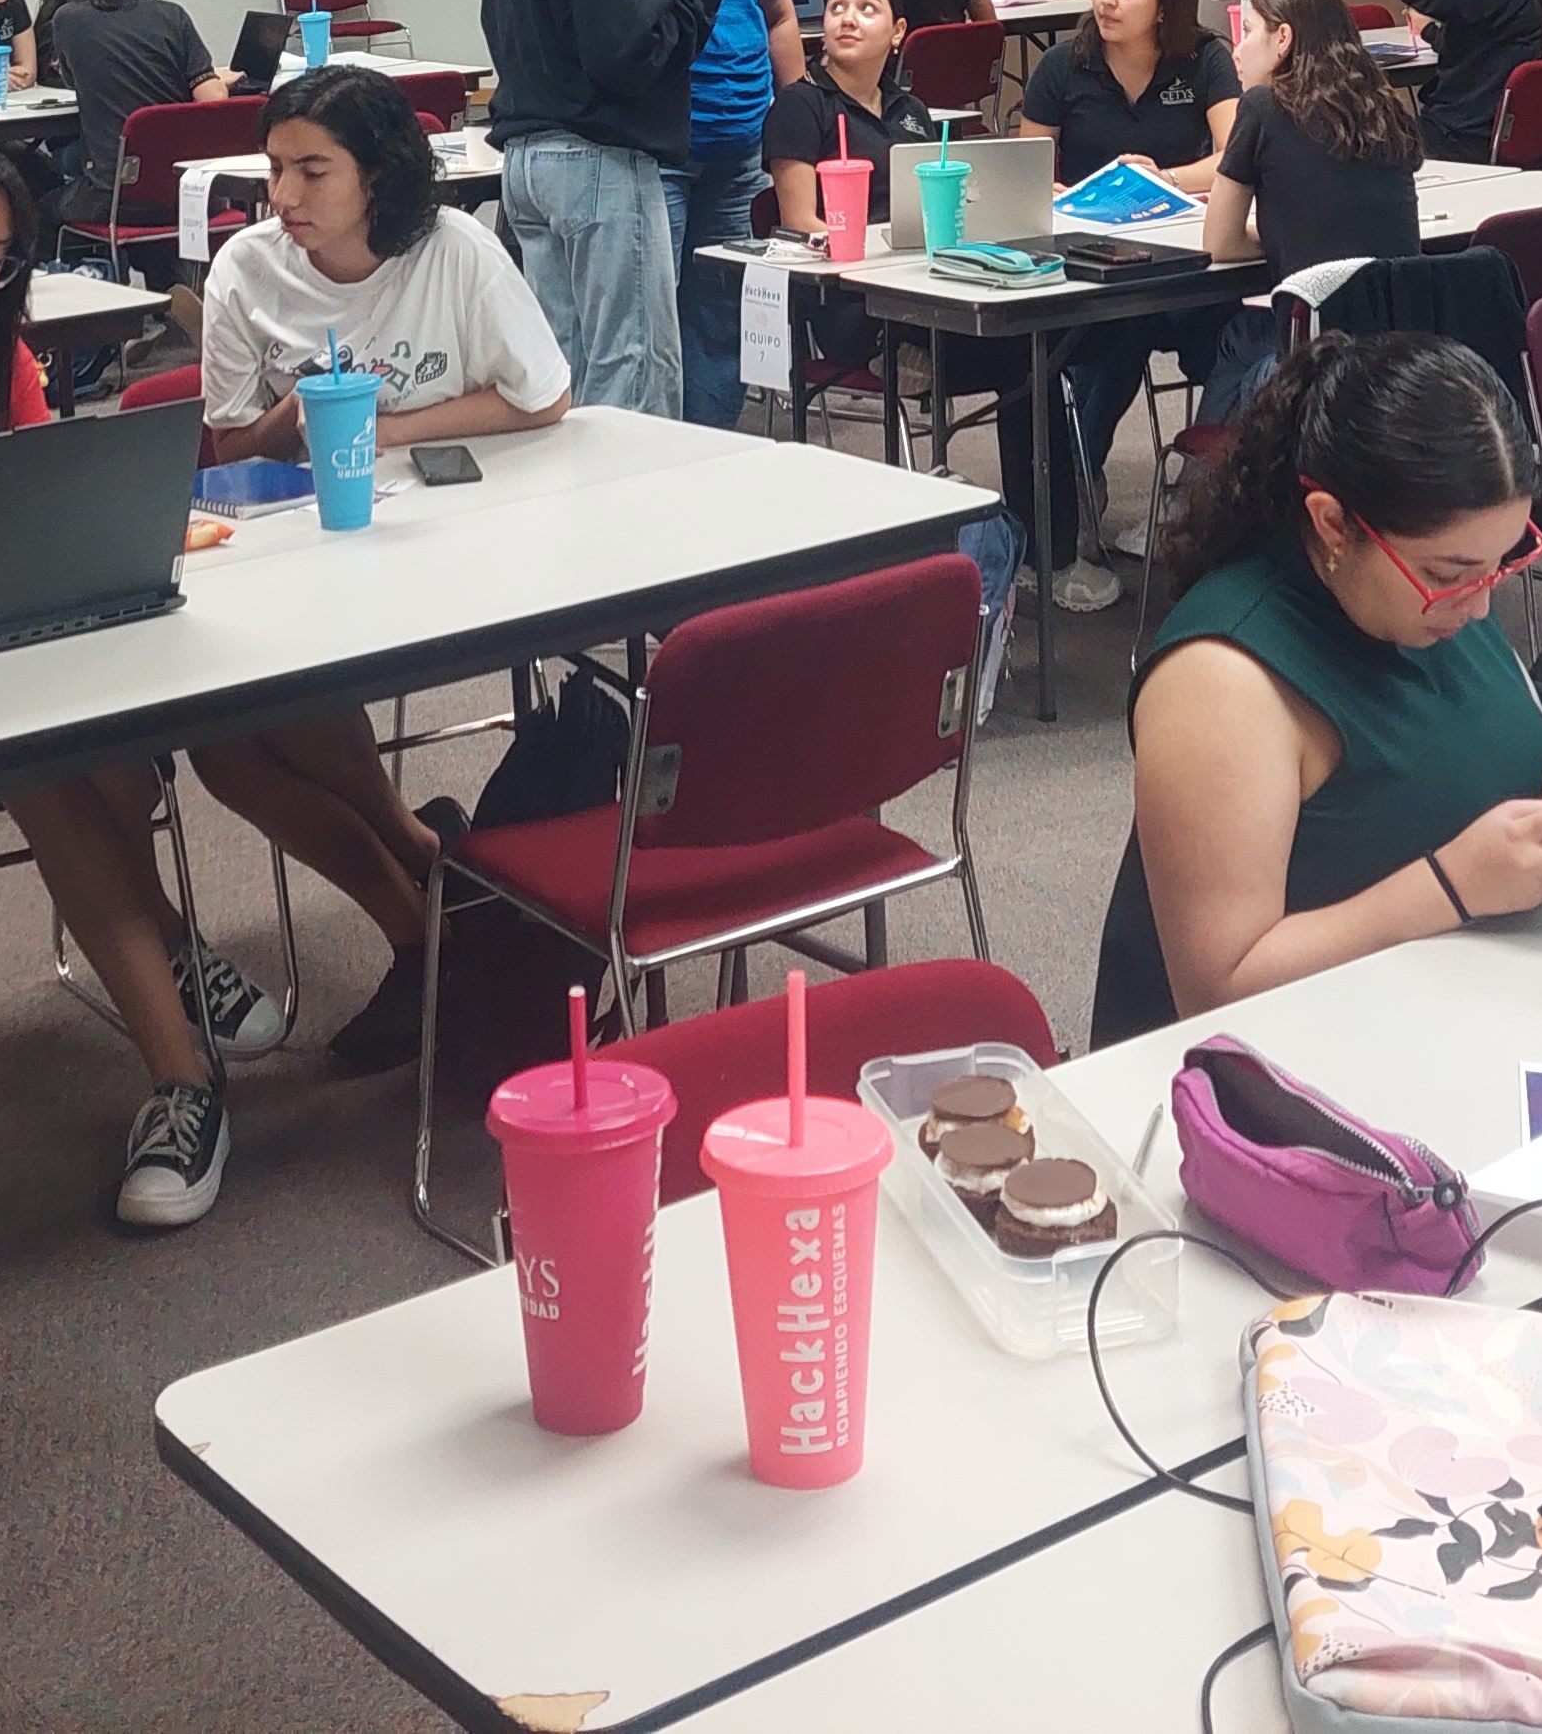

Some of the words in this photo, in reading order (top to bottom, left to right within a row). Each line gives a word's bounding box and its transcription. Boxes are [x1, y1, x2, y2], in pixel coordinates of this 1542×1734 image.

[1159, 88, 1196, 101] CETYS
[744, 329, 781, 348] EQUIPO
[759, 351, 766, 363] 7
[832, 1203, 849, 1317] ESQUEMAS
[776, 1207, 834, 1456] HackHexa
[834, 1322, 851, 1448] ROMPIENDO
